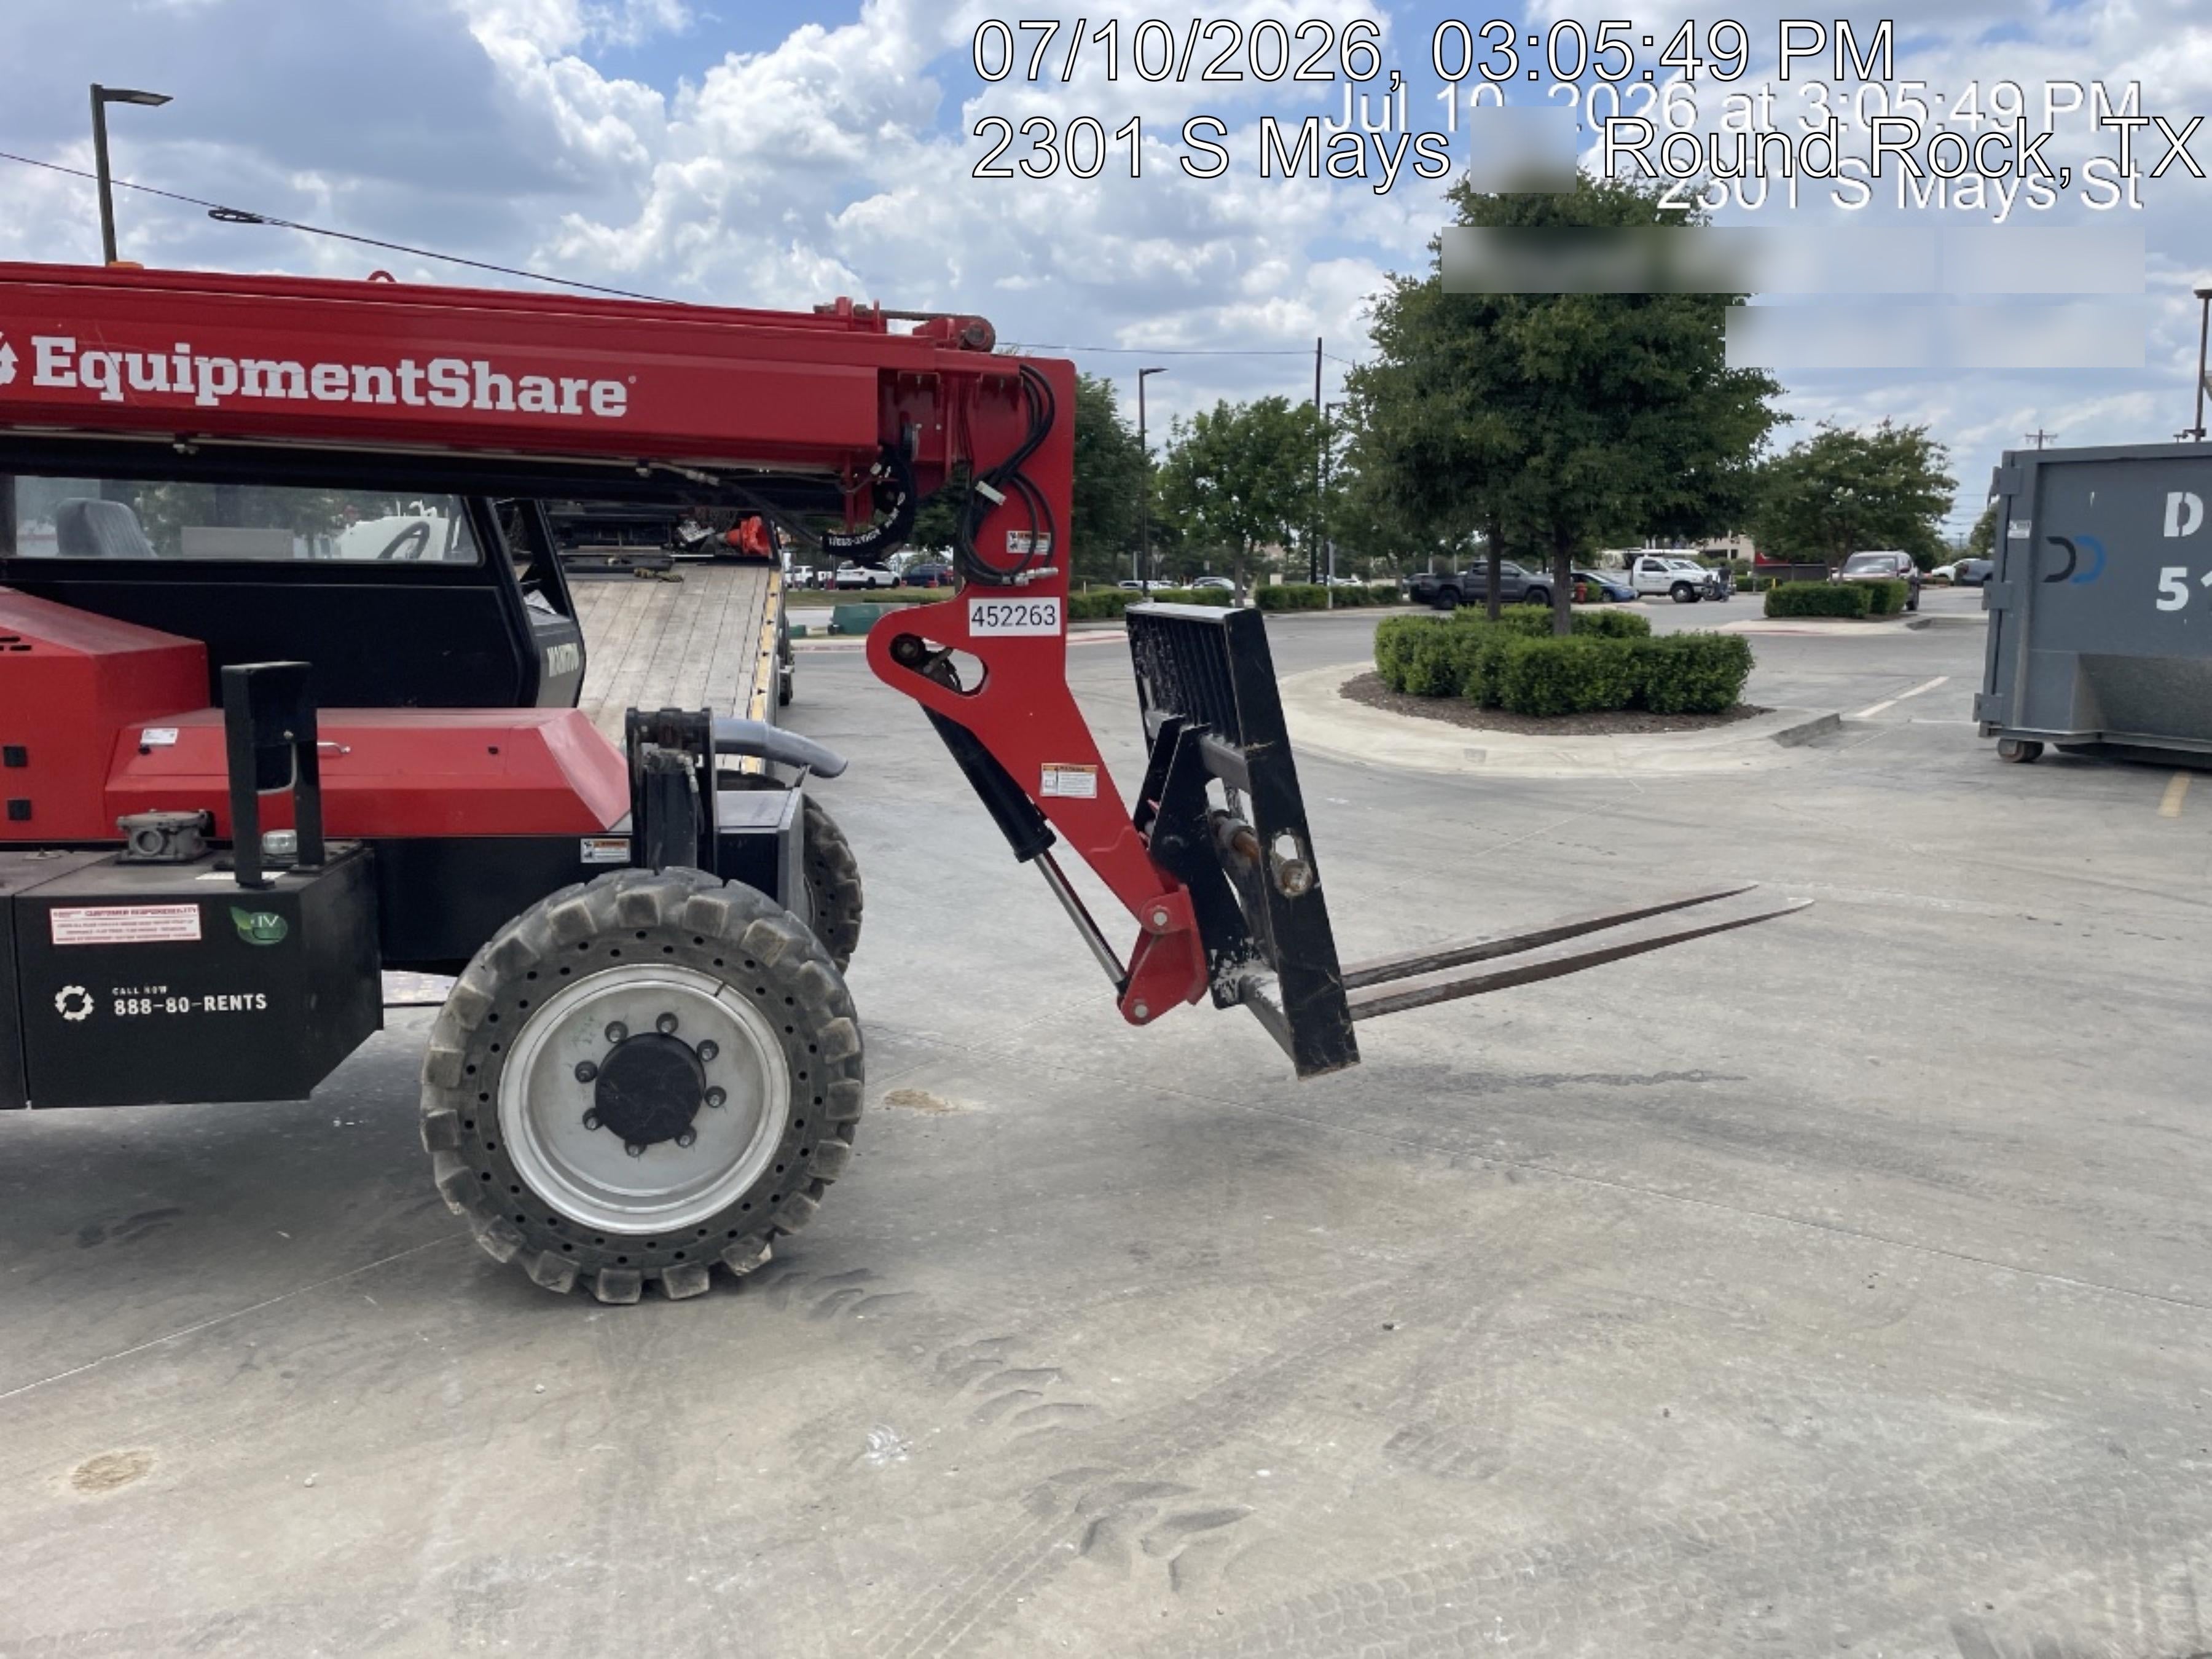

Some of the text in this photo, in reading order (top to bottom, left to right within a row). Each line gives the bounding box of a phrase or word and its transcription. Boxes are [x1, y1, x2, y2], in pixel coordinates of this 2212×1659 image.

[31, 335, 627, 417] EquipmentShare
[971, 605, 1056, 627] 452263
[143, 986, 167, 995] NOW
[114, 993, 267, 1016] 888-80-RENTS
